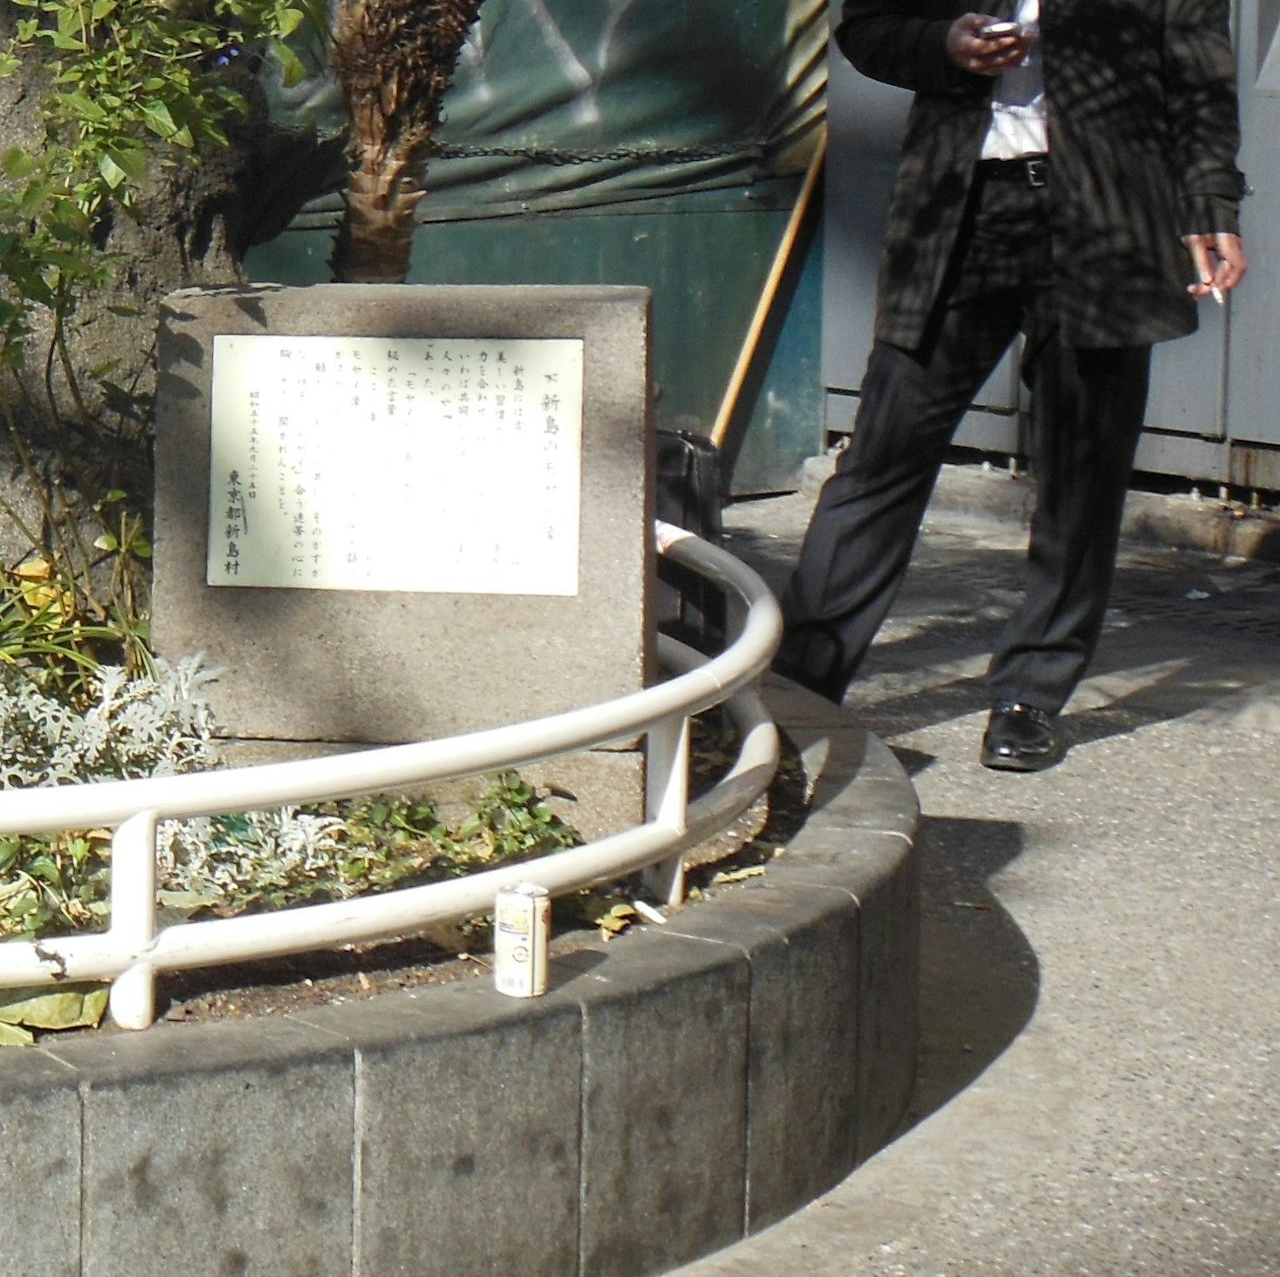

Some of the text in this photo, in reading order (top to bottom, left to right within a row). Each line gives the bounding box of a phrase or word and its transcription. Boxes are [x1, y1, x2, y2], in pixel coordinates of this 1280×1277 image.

[223, 469, 242, 576] 東京都新島村
